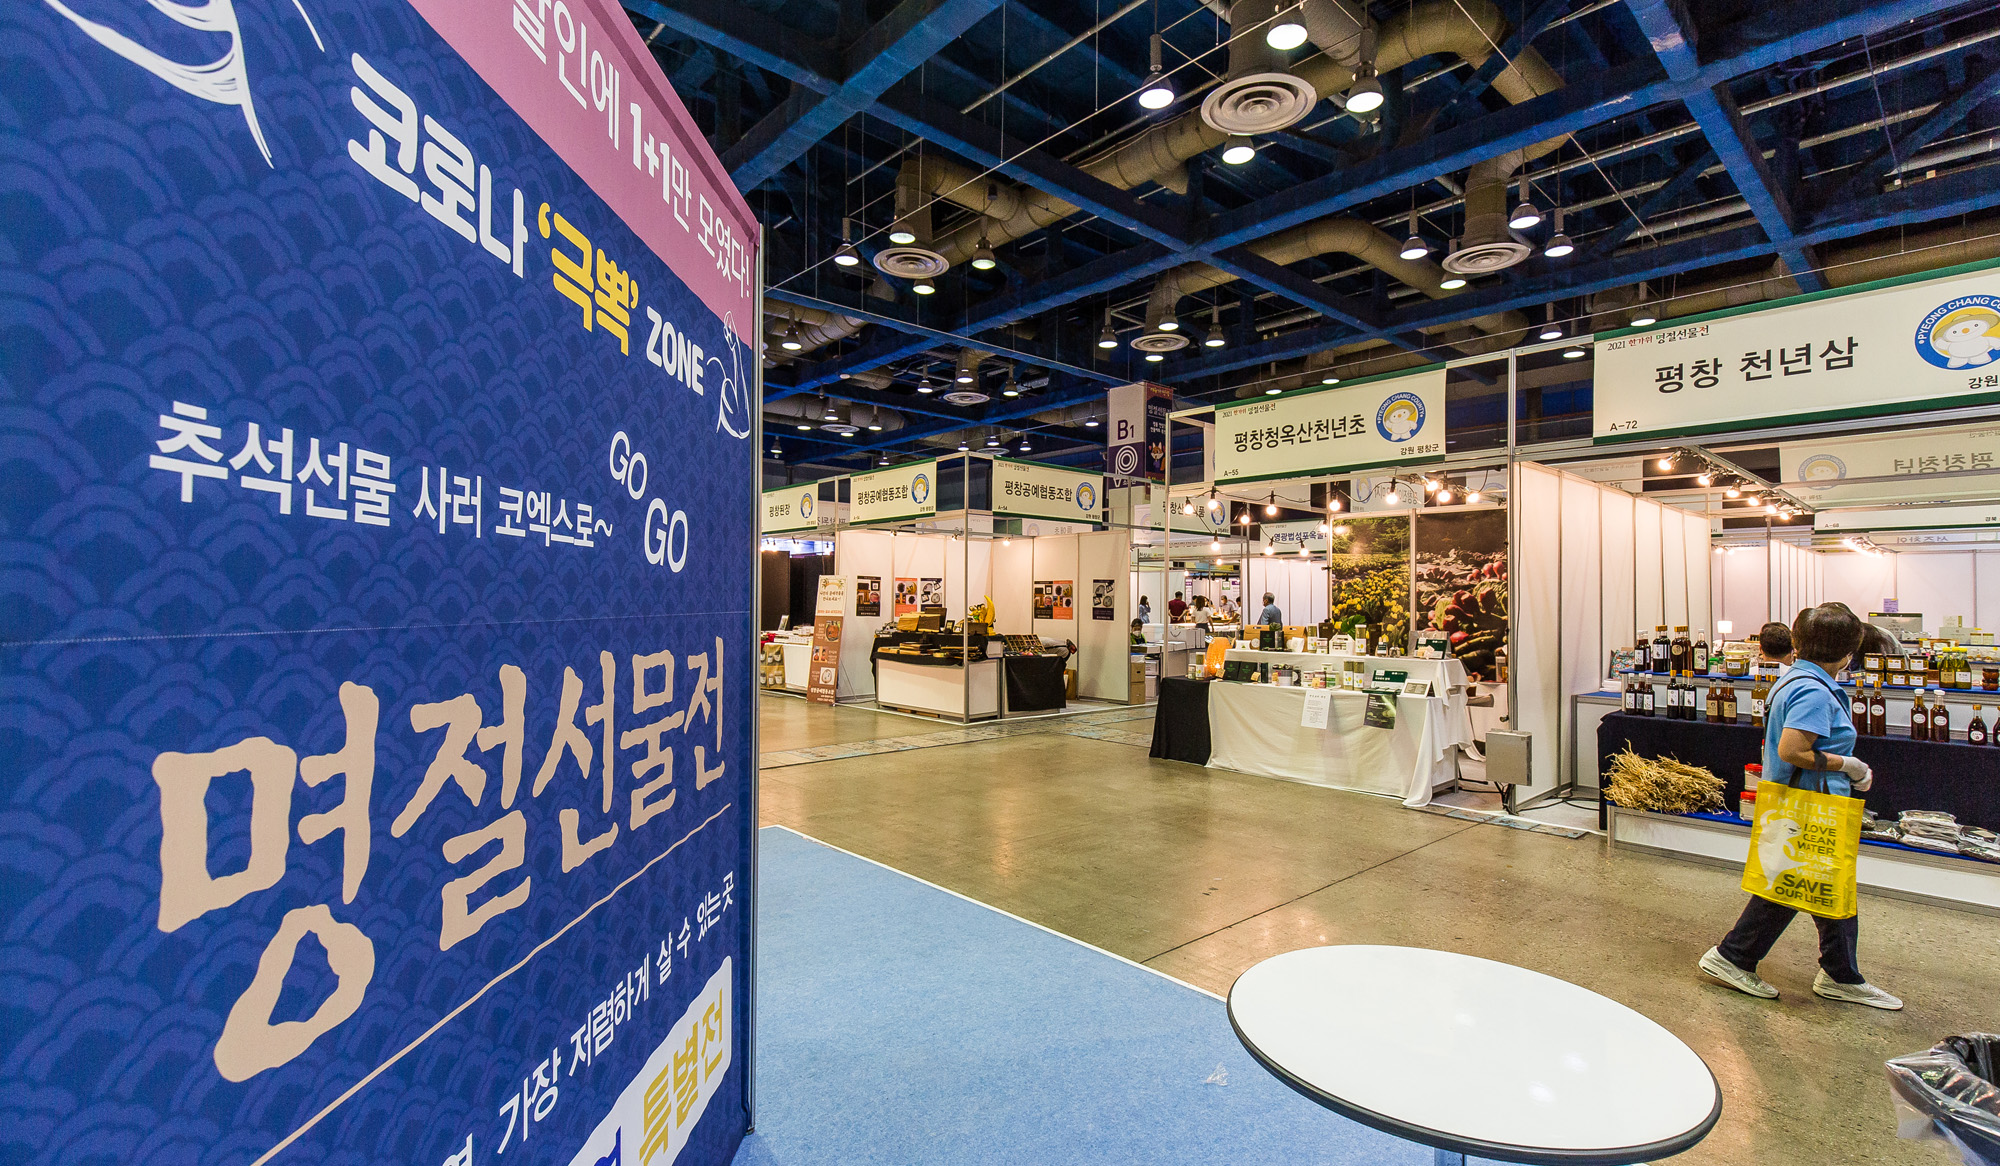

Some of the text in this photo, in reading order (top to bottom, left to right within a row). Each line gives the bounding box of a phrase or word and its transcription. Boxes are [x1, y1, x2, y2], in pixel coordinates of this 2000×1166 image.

[630, 102, 692, 233] 1+1만
[697, 192, 750, 299] 모였다!
[347, 52, 529, 278] 코로나
[646, 305, 704, 397] ZONE
[1607, 324, 1710, 351] 2021 한가위 명절선물전
[1917, 306, 1948, 340] PYEONG
[1947, 296, 1990, 310] CHANG
[1654, 336, 1860, 394] 평창 천년삼
[1968, 374, 1999, 390] 강원
[1233, 413, 1367, 453] 평창청옥산천년초
[1609, 420, 1638, 432] A-72
[610, 430, 648, 500] GO
[1400, 443, 1440, 456] 강원 평창군
[149, 399, 613, 549] 추석선물 사러 코엑스로~
[1004, 480, 1073, 503] 평창공예협동조합
[1223, 468, 1240, 477] A-55
[857, 484, 909, 506] 평창공예협동조합
[643, 498, 689, 574] GO
[151, 636, 725, 1084] 명절선물전
[1774, 886, 1834, 908] OUR LIFE!
[1782, 873, 1834, 897] SAVE
[496, 1046, 562, 1155] 가장
[568, 952, 650, 1078] 저렴하게
[656, 931, 673, 986] 살
[676, 916, 691, 959] 수
[639, 987, 723, 1166] 특별전
